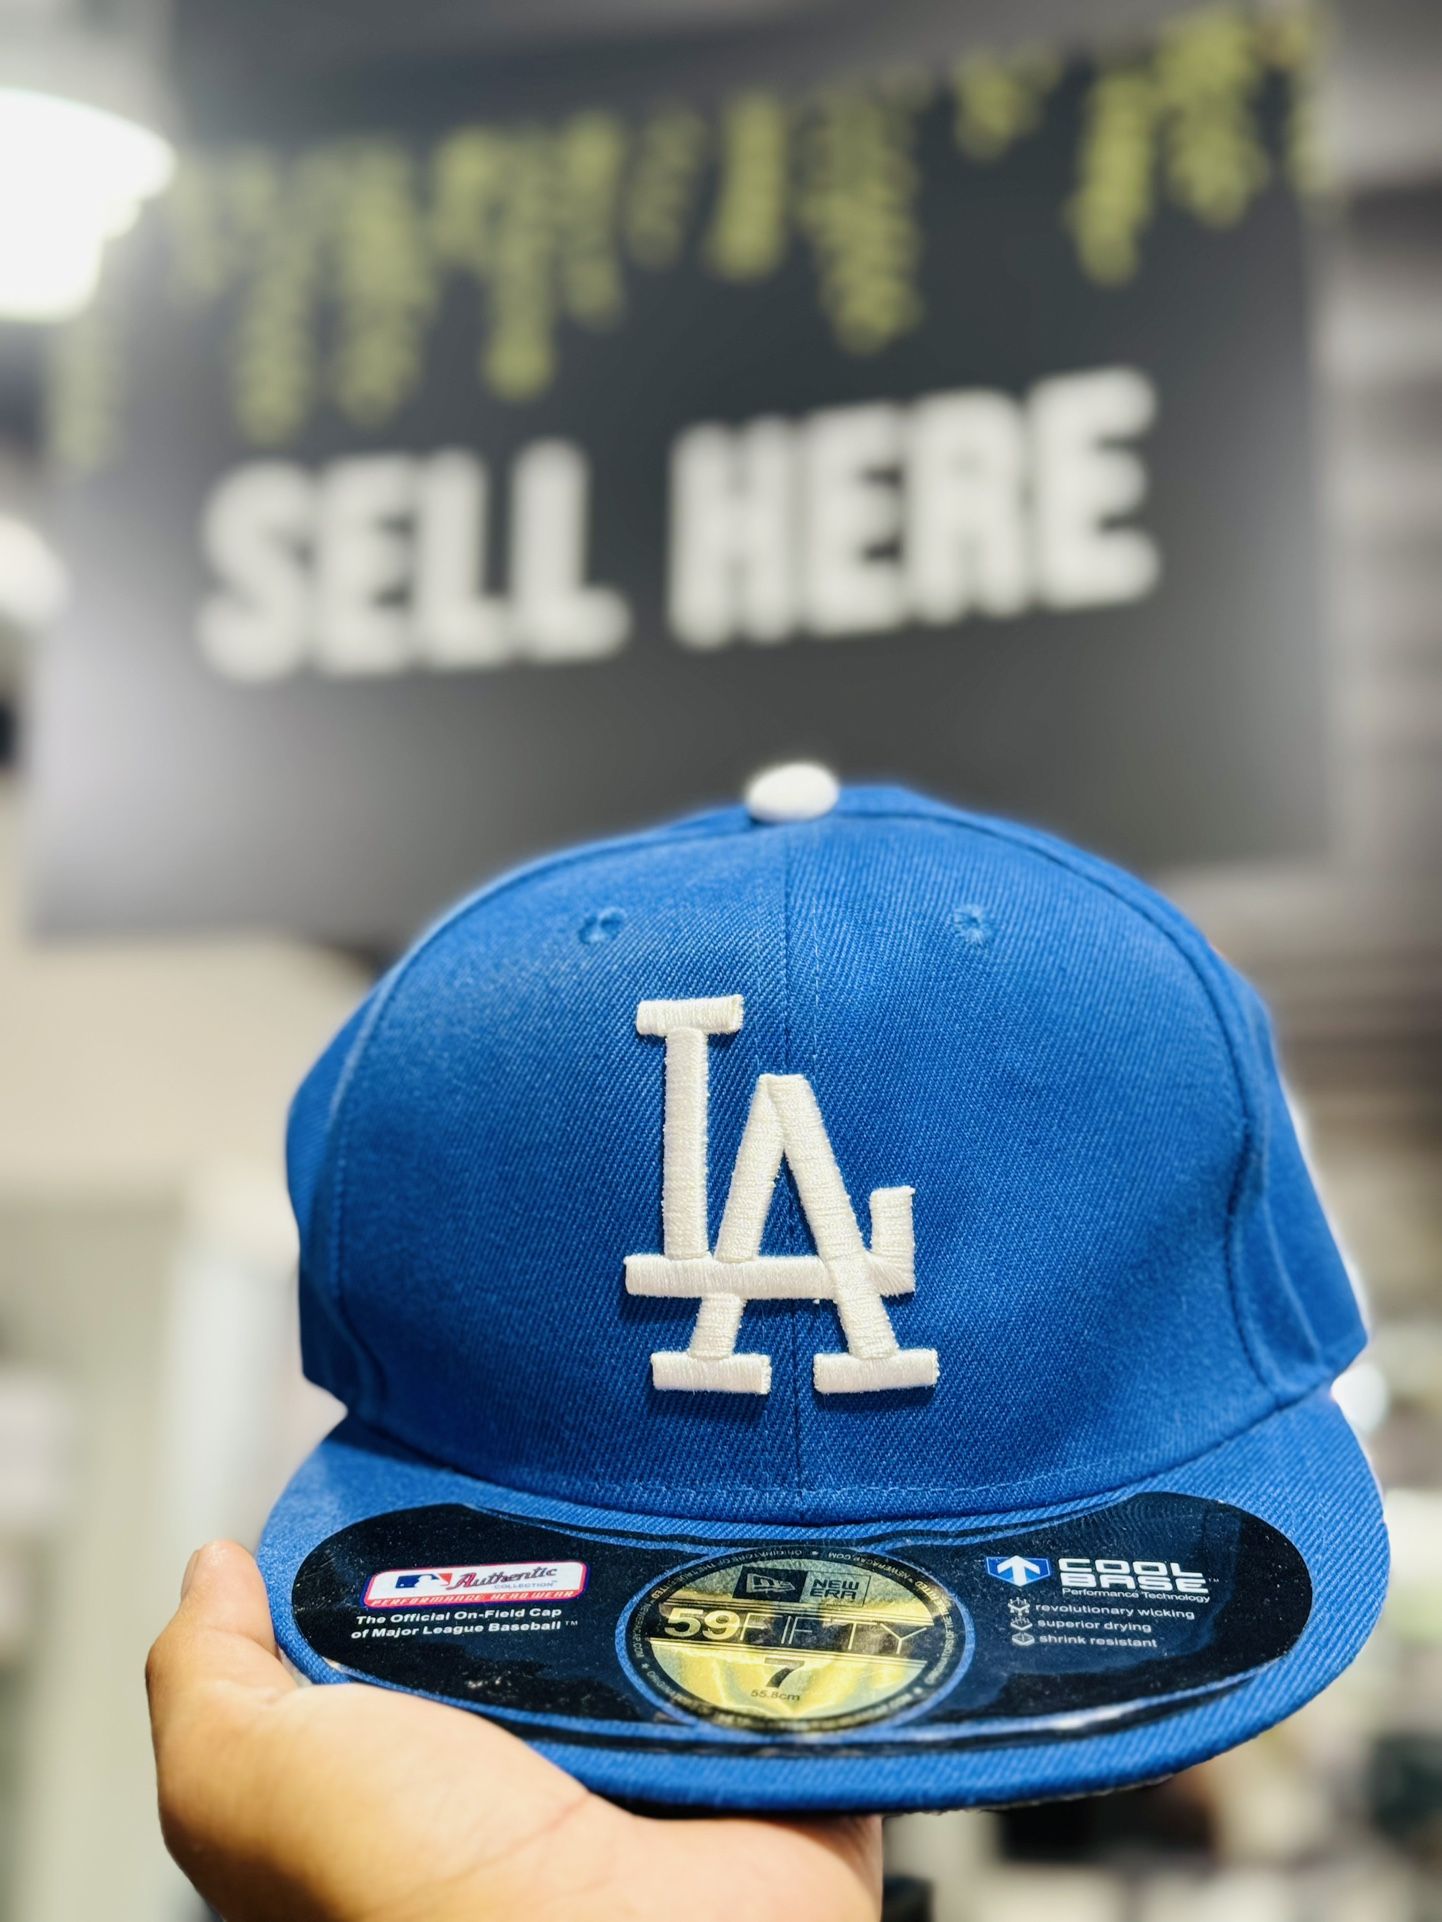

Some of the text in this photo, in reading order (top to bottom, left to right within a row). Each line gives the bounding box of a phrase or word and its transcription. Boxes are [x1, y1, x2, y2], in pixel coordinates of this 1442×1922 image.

[203, 367, 1159, 681] SELL HERE
[623, 995, 939, 1395] LA
[1058, 1557, 1203, 1578] COOL
[446, 1566, 558, 1591] Authentic
[812, 1578, 861, 1591] NEW
[1060, 1573, 1209, 1594] BASE
[809, 1589, 858, 1600] ERA
[1062, 1587, 1210, 1603] Performance Technology
[356, 1607, 562, 1625] The Official On-Field Cap
[1035, 1604, 1195, 1620] revolutionary wicking
[351, 1629, 369, 1639] of
[372, 1626, 419, 1639] Major
[423, 1624, 485, 1636] League
[488, 1620, 561, 1632] Baseball
[664, 1606, 928, 1655] 59FIFTY
[1037, 1619, 1152, 1633] superior drying
[1039, 1634, 1157, 1648] shrink resistant
[764, 1657, 805, 1689] 7
[750, 1689, 801, 1702] 55.8cm
